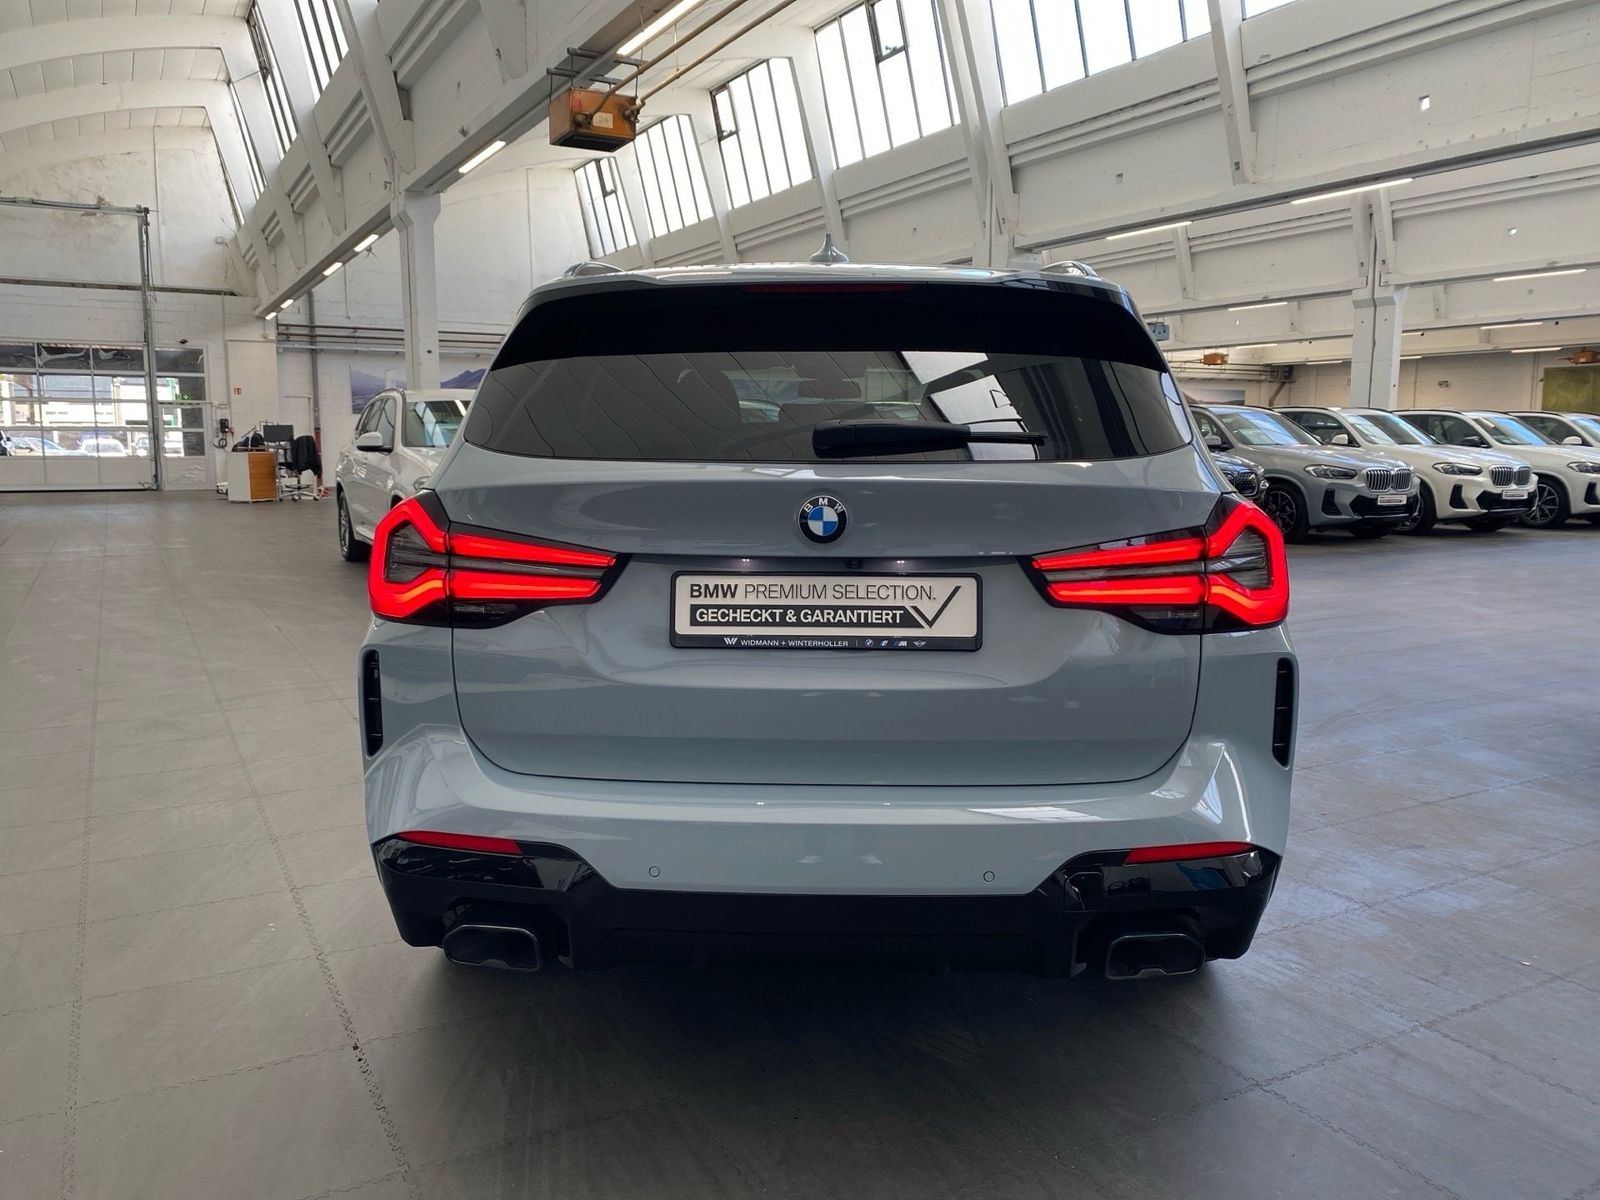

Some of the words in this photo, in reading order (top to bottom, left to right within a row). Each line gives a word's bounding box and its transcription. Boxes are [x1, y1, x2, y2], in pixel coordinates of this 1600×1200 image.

[803, 497, 844, 514] BMW
[690, 583, 738, 599] BMW
[744, 584, 827, 600] PREMIUM
[832, 584, 936, 600] SELECTION.
[696, 608, 783, 623] GECHECKT
[786, 609, 797, 623] &
[800, 609, 904, 624] GARANTIERT
[740, 639, 779, 647] WIDMANN
[788, 639, 849, 647] WINTERHOLLER
